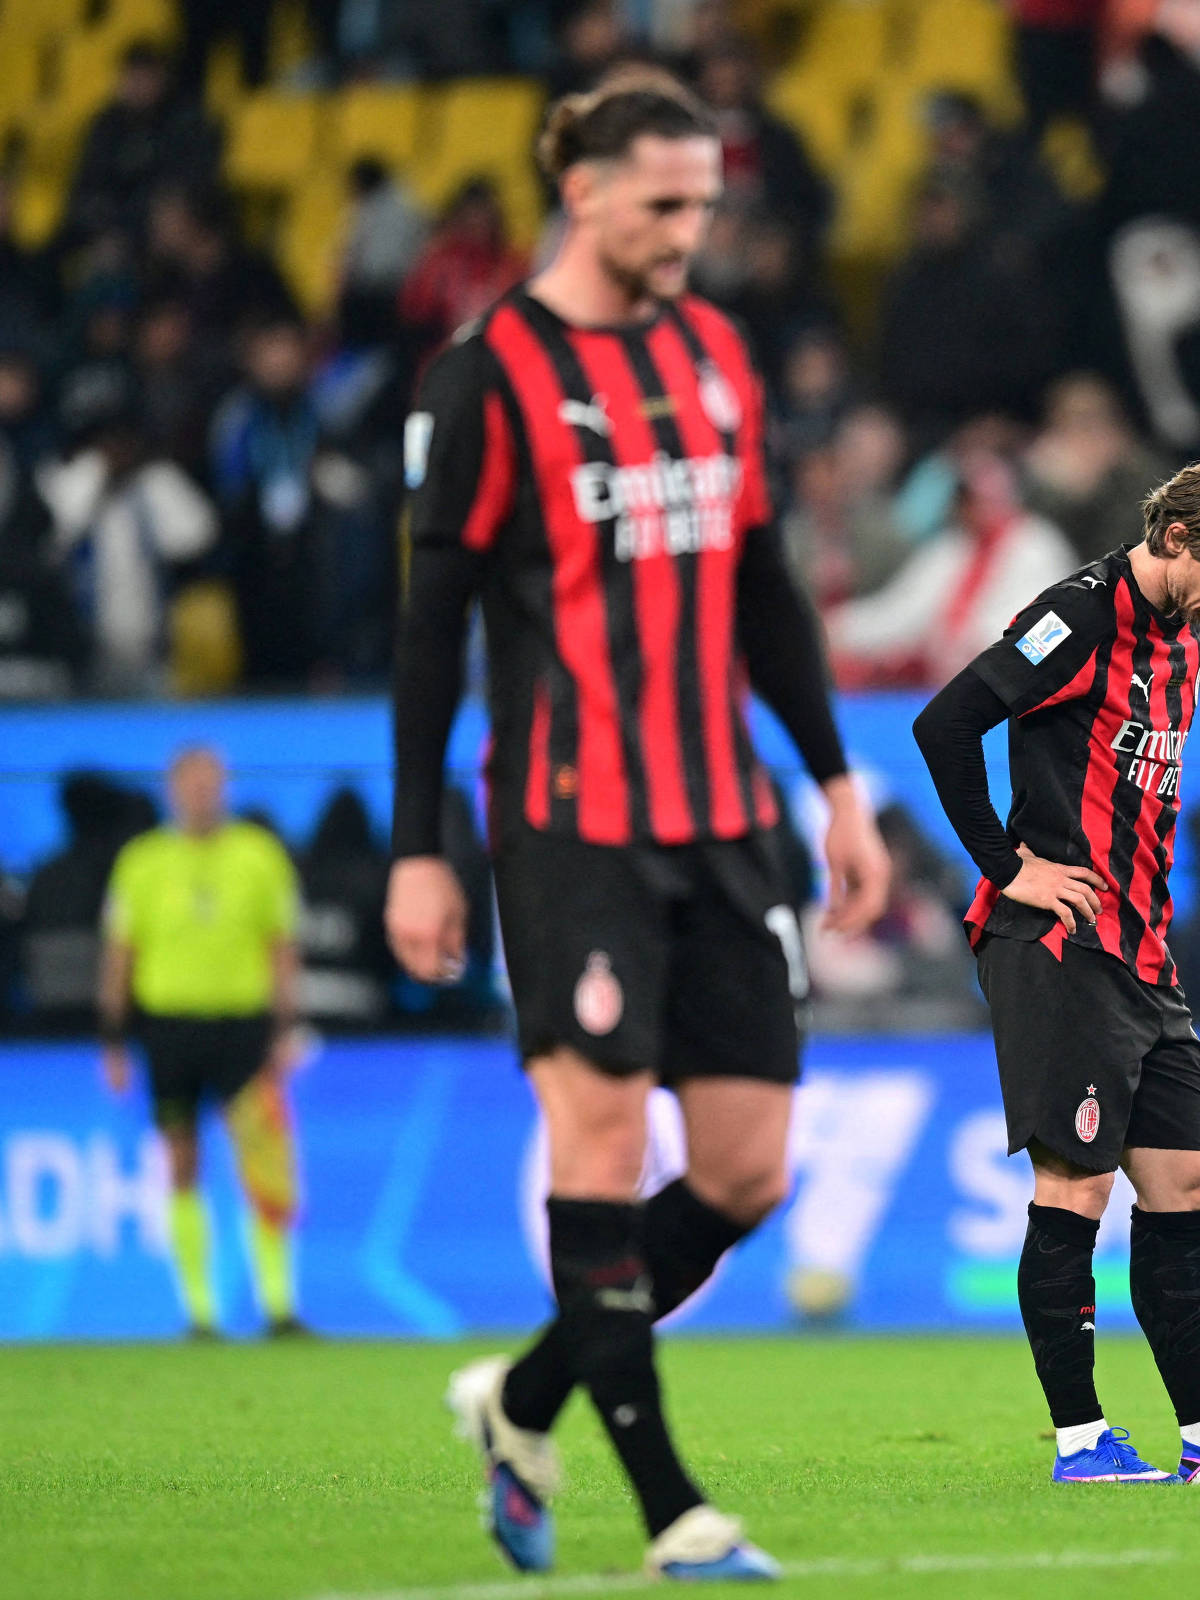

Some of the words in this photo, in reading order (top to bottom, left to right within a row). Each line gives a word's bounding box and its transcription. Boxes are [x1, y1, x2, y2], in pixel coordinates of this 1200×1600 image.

[1128, 759, 1159, 791] FLY
[1157, 766, 1182, 796] BET
[0, 1131, 170, 1254] DH
